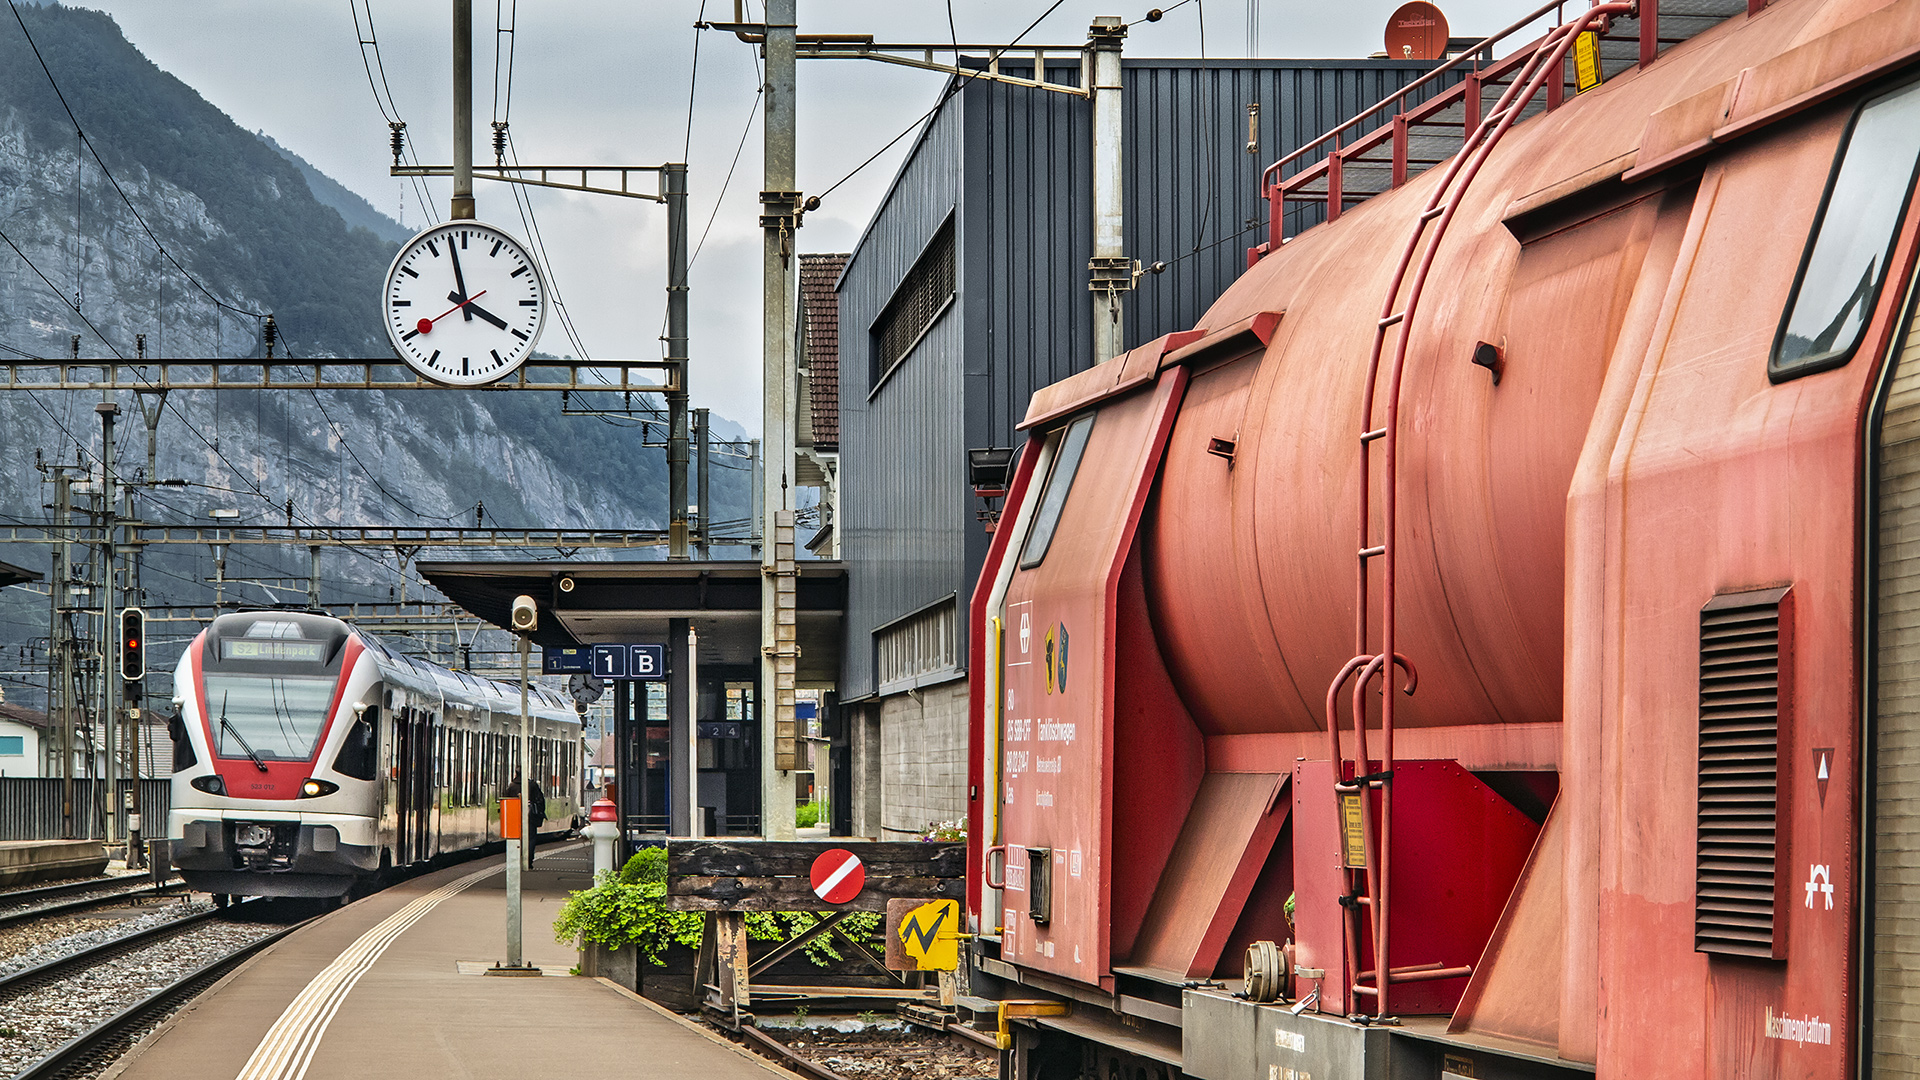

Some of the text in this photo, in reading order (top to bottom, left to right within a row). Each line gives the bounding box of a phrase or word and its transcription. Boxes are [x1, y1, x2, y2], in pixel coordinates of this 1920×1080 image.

[237, 643, 316, 657] S2 Lindenpark
[552, 660, 557, 668] 1
[604, 655, 613, 673] 1
[638, 655, 654, 673] B
[1007, 688, 1015, 711] 80
[712, 727, 736, 736] 2 4
[1007, 718, 1032, 741] 85 SBB-CFF
[1037, 718, 1076, 745] Tanklöschwagen
[1765, 1005, 1831, 1049] Maschinenplattform
